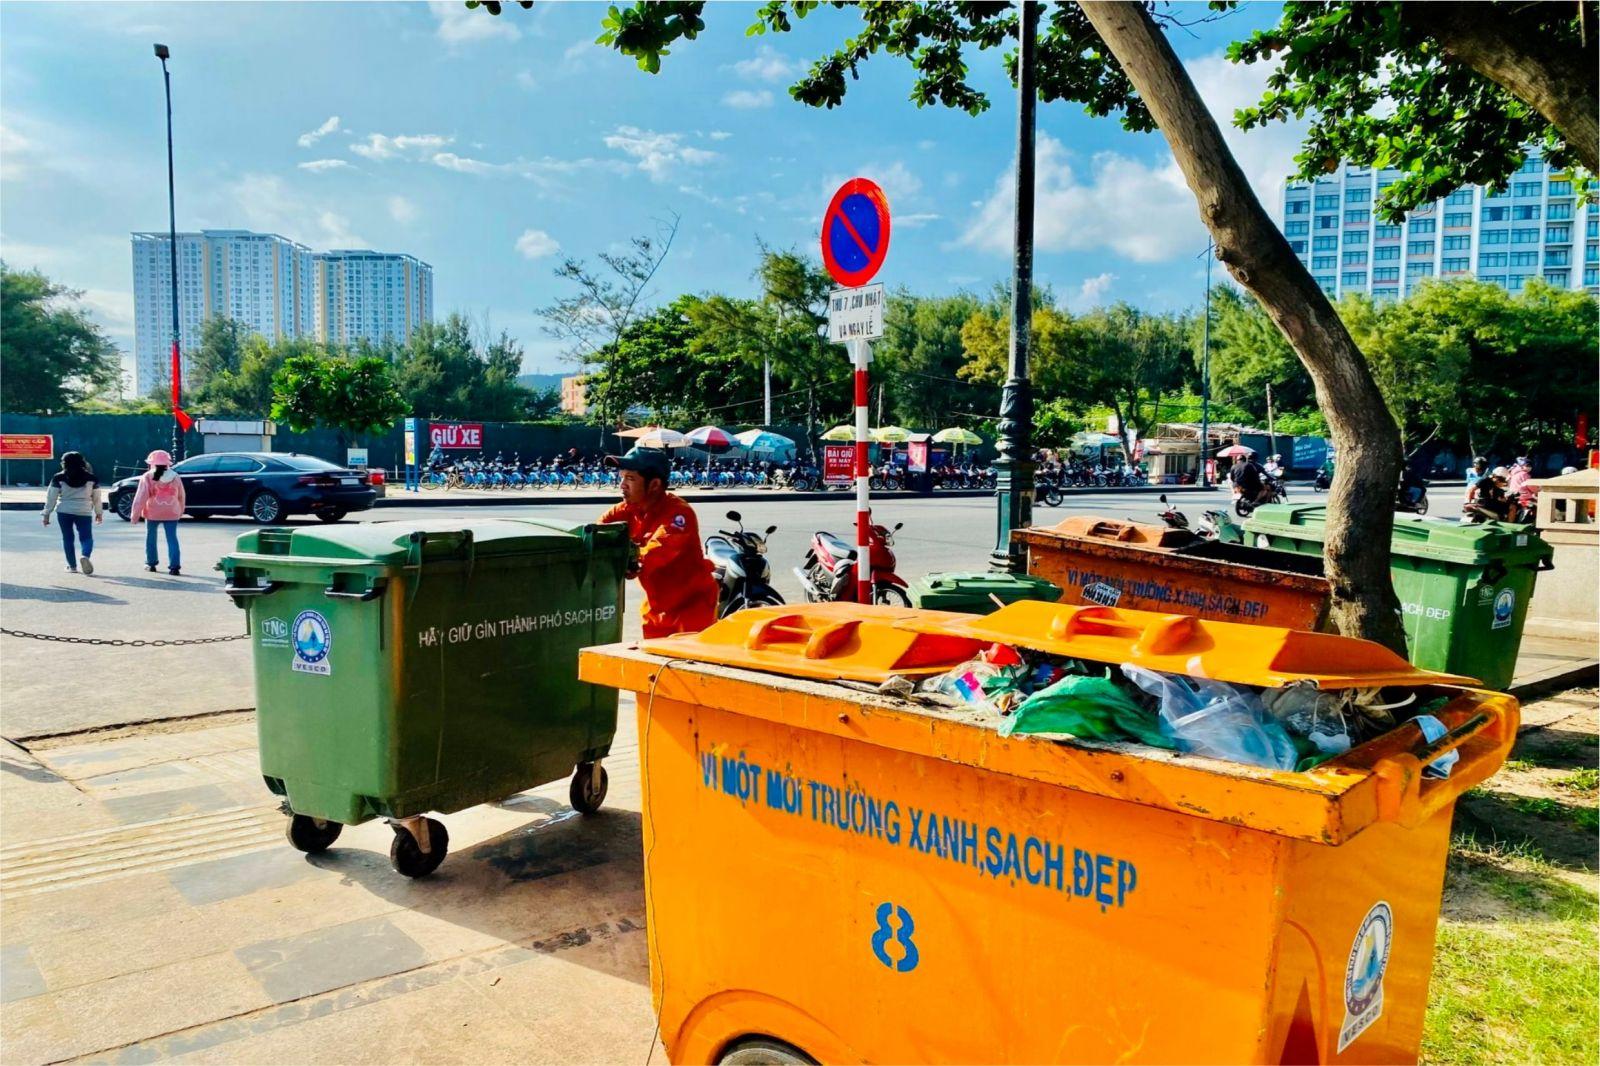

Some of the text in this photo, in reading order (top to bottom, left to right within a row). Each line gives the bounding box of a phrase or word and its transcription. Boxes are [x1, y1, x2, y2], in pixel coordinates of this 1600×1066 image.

[431, 424, 481, 446] GIỮ XE
[264, 621, 286, 636] TNC
[296, 663, 327, 673] VESCO
[721, 750, 762, 809] MỘT
[871, 902, 920, 973] 8
